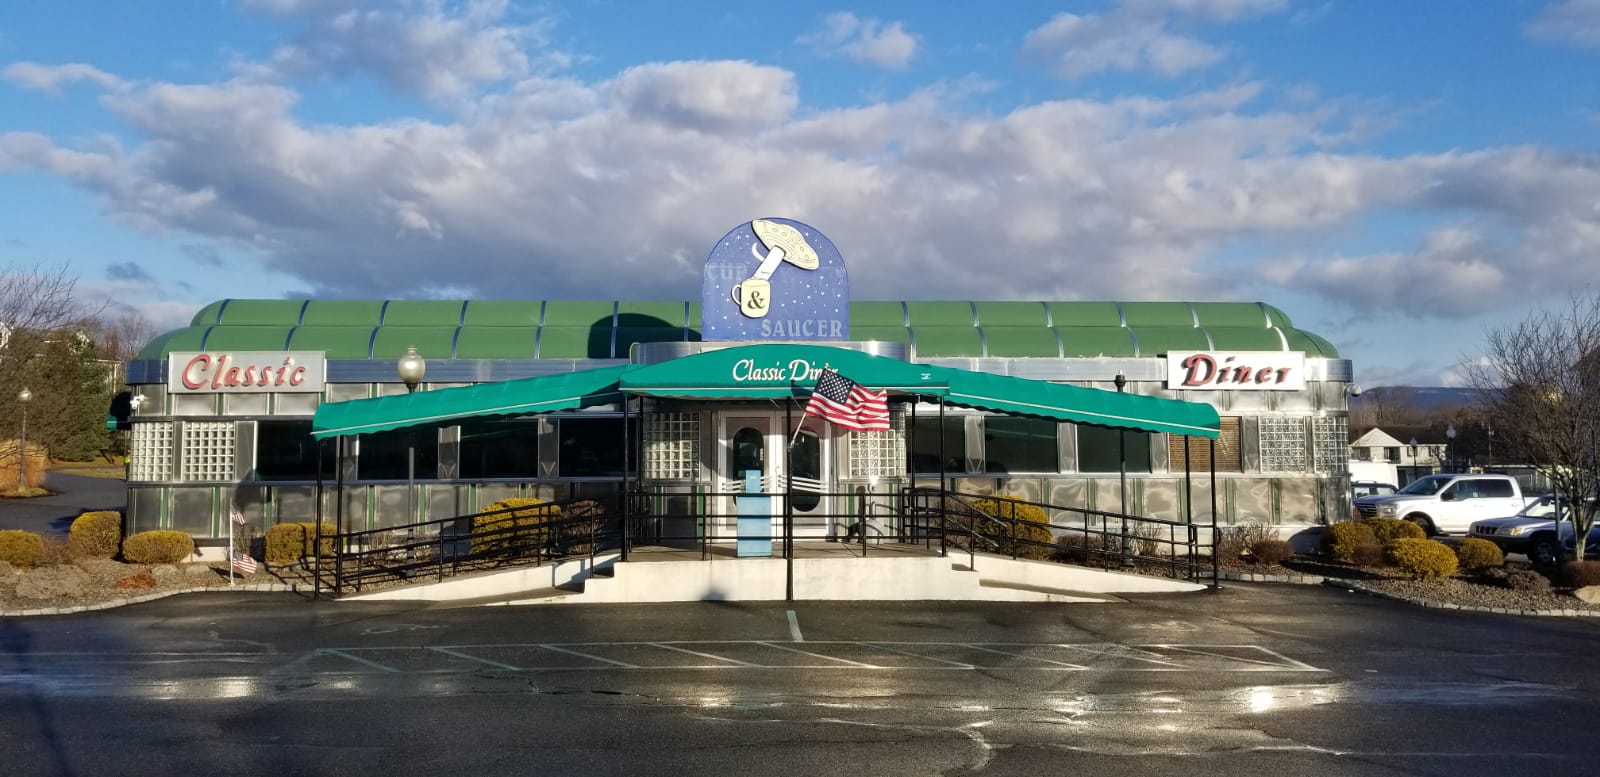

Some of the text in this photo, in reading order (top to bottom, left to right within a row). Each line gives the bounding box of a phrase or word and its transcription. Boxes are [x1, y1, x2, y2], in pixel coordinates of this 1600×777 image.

[747, 290, 765, 309] &
[760, 319, 843, 338] SAUCER
[182, 353, 305, 389] Classic
[732, 359, 839, 381] Classic Din
[1180, 353, 1292, 387] Diner
